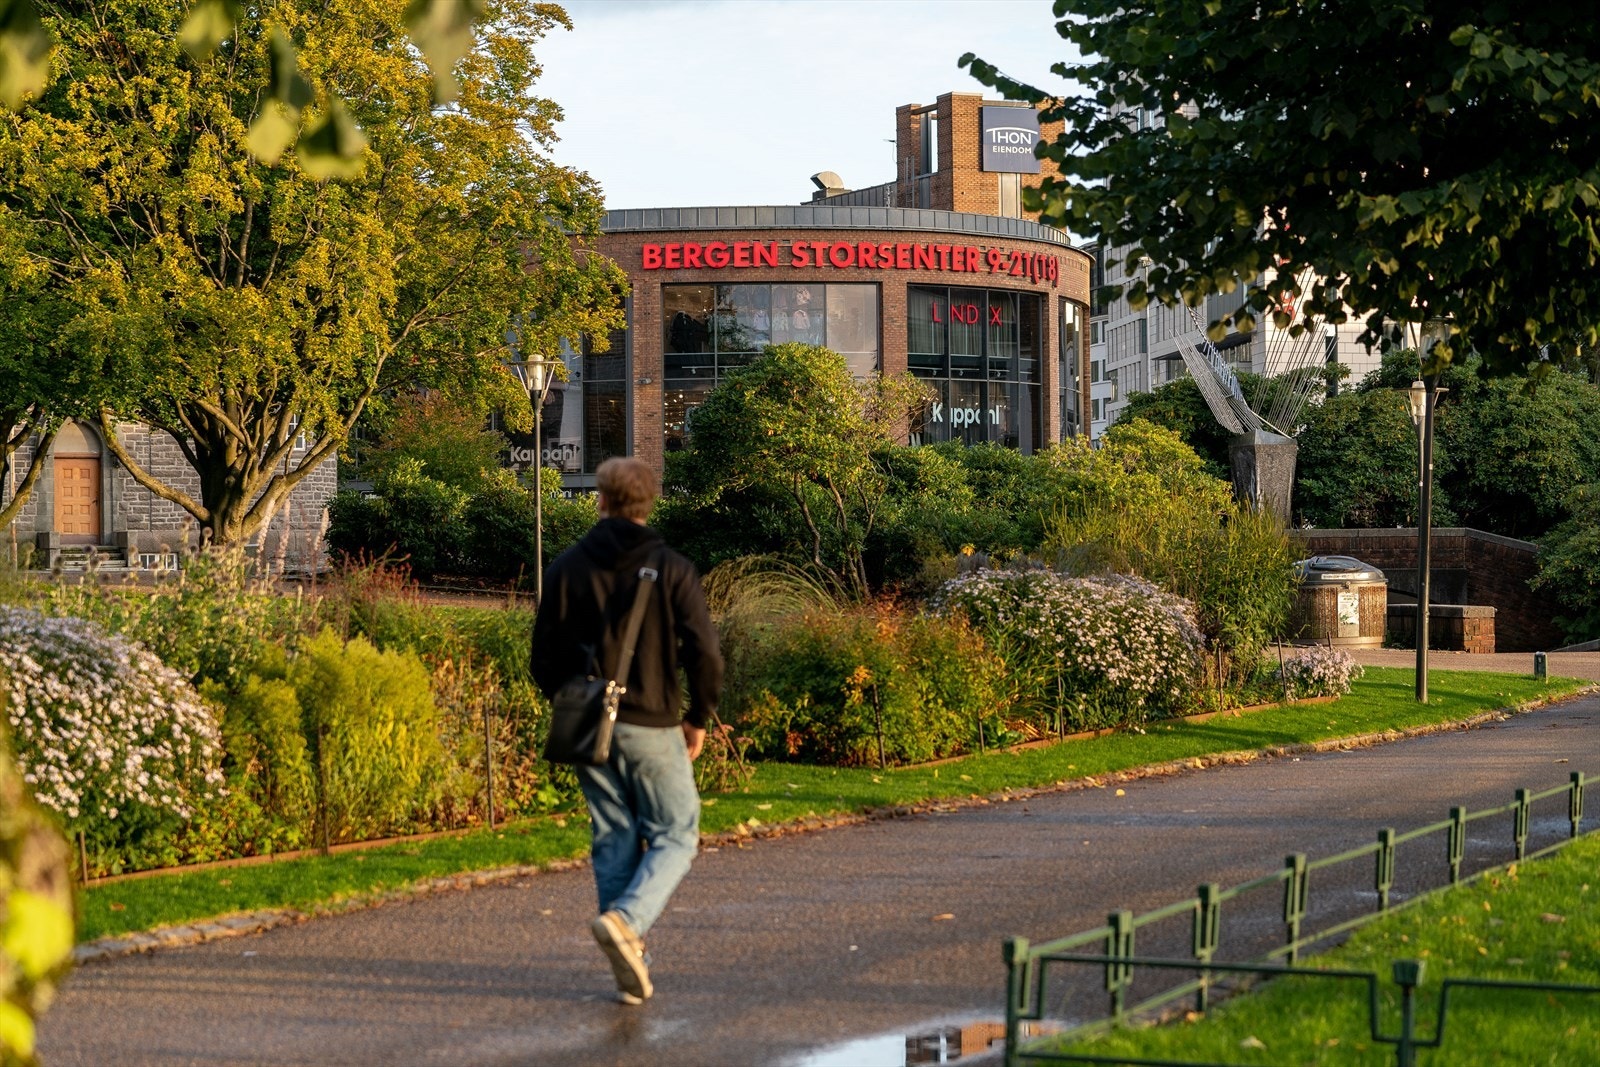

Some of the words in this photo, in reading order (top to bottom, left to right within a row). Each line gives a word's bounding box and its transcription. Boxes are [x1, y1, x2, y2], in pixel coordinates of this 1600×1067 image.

[986, 127, 1038, 145] THON
[992, 146, 1032, 154] EIENDOM
[643, 241, 779, 270] BERGEN
[791, 241, 981, 273] STORSENTER
[986, 248, 1059, 288] 9-21(18)
[932, 302, 1003, 326] LNDX
